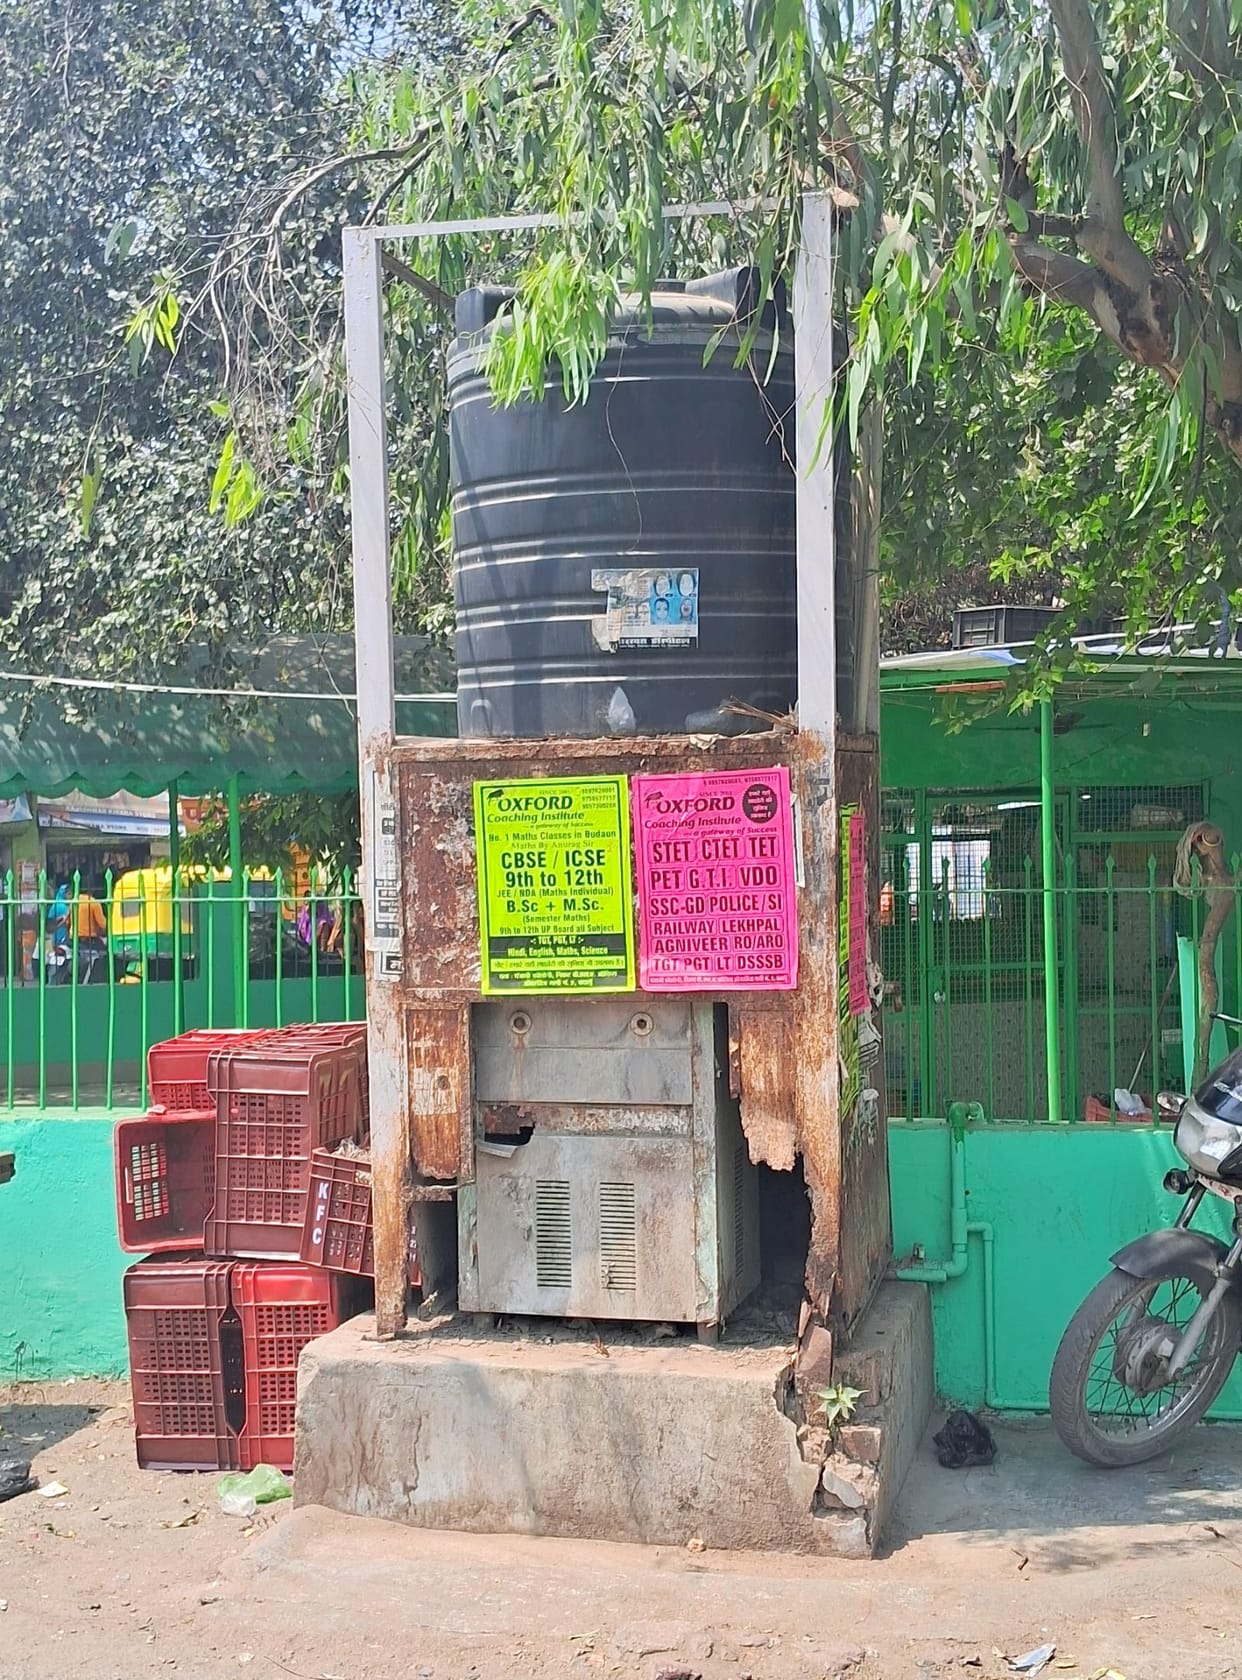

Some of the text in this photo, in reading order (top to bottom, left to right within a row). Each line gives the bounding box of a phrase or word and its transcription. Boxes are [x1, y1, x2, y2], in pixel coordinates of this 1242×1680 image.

[498, 796, 573, 811] OXFORD
[657, 797, 735, 814] OXFORD
[488, 812, 584, 823] Coaching Institute
[644, 816, 741, 829] Coaching Institute
[489, 834, 501, 842] No.
[513, 832, 537, 840] Maths
[540, 831, 572, 839] Classes
[585, 830, 616, 838] Budaun
[700, 829, 734, 837] gateway
[653, 837, 776, 863] STET CTET TET
[502, 850, 605, 869] CBSE / ICSE
[506, 869, 603, 888] 9th to 12th
[651, 866, 777, 890] PET G.T.I. VDO
[497, 890, 511, 898] JEE
[520, 889, 536, 897] NDA
[539, 889, 567, 897] (Maths
[570, 888, 613, 896] Individual)
[507, 898, 604, 913] B.Sc + M.Sc.
[650, 897, 704, 915] SSC-GD
[523, 914, 590, 924] (Semester Maths)
[654, 918, 780, 935] RAILWAY LEKHPAL
[588, 924, 614, 933] Subject
[508, 946, 608, 957] Hindi, English, Maths, Science
[655, 935, 783, 953] AGNIVEER RO/ARO
[653, 955, 783, 971] TGT PGT LT DSSSB
[312, 1182, 329, 1245] KFC
